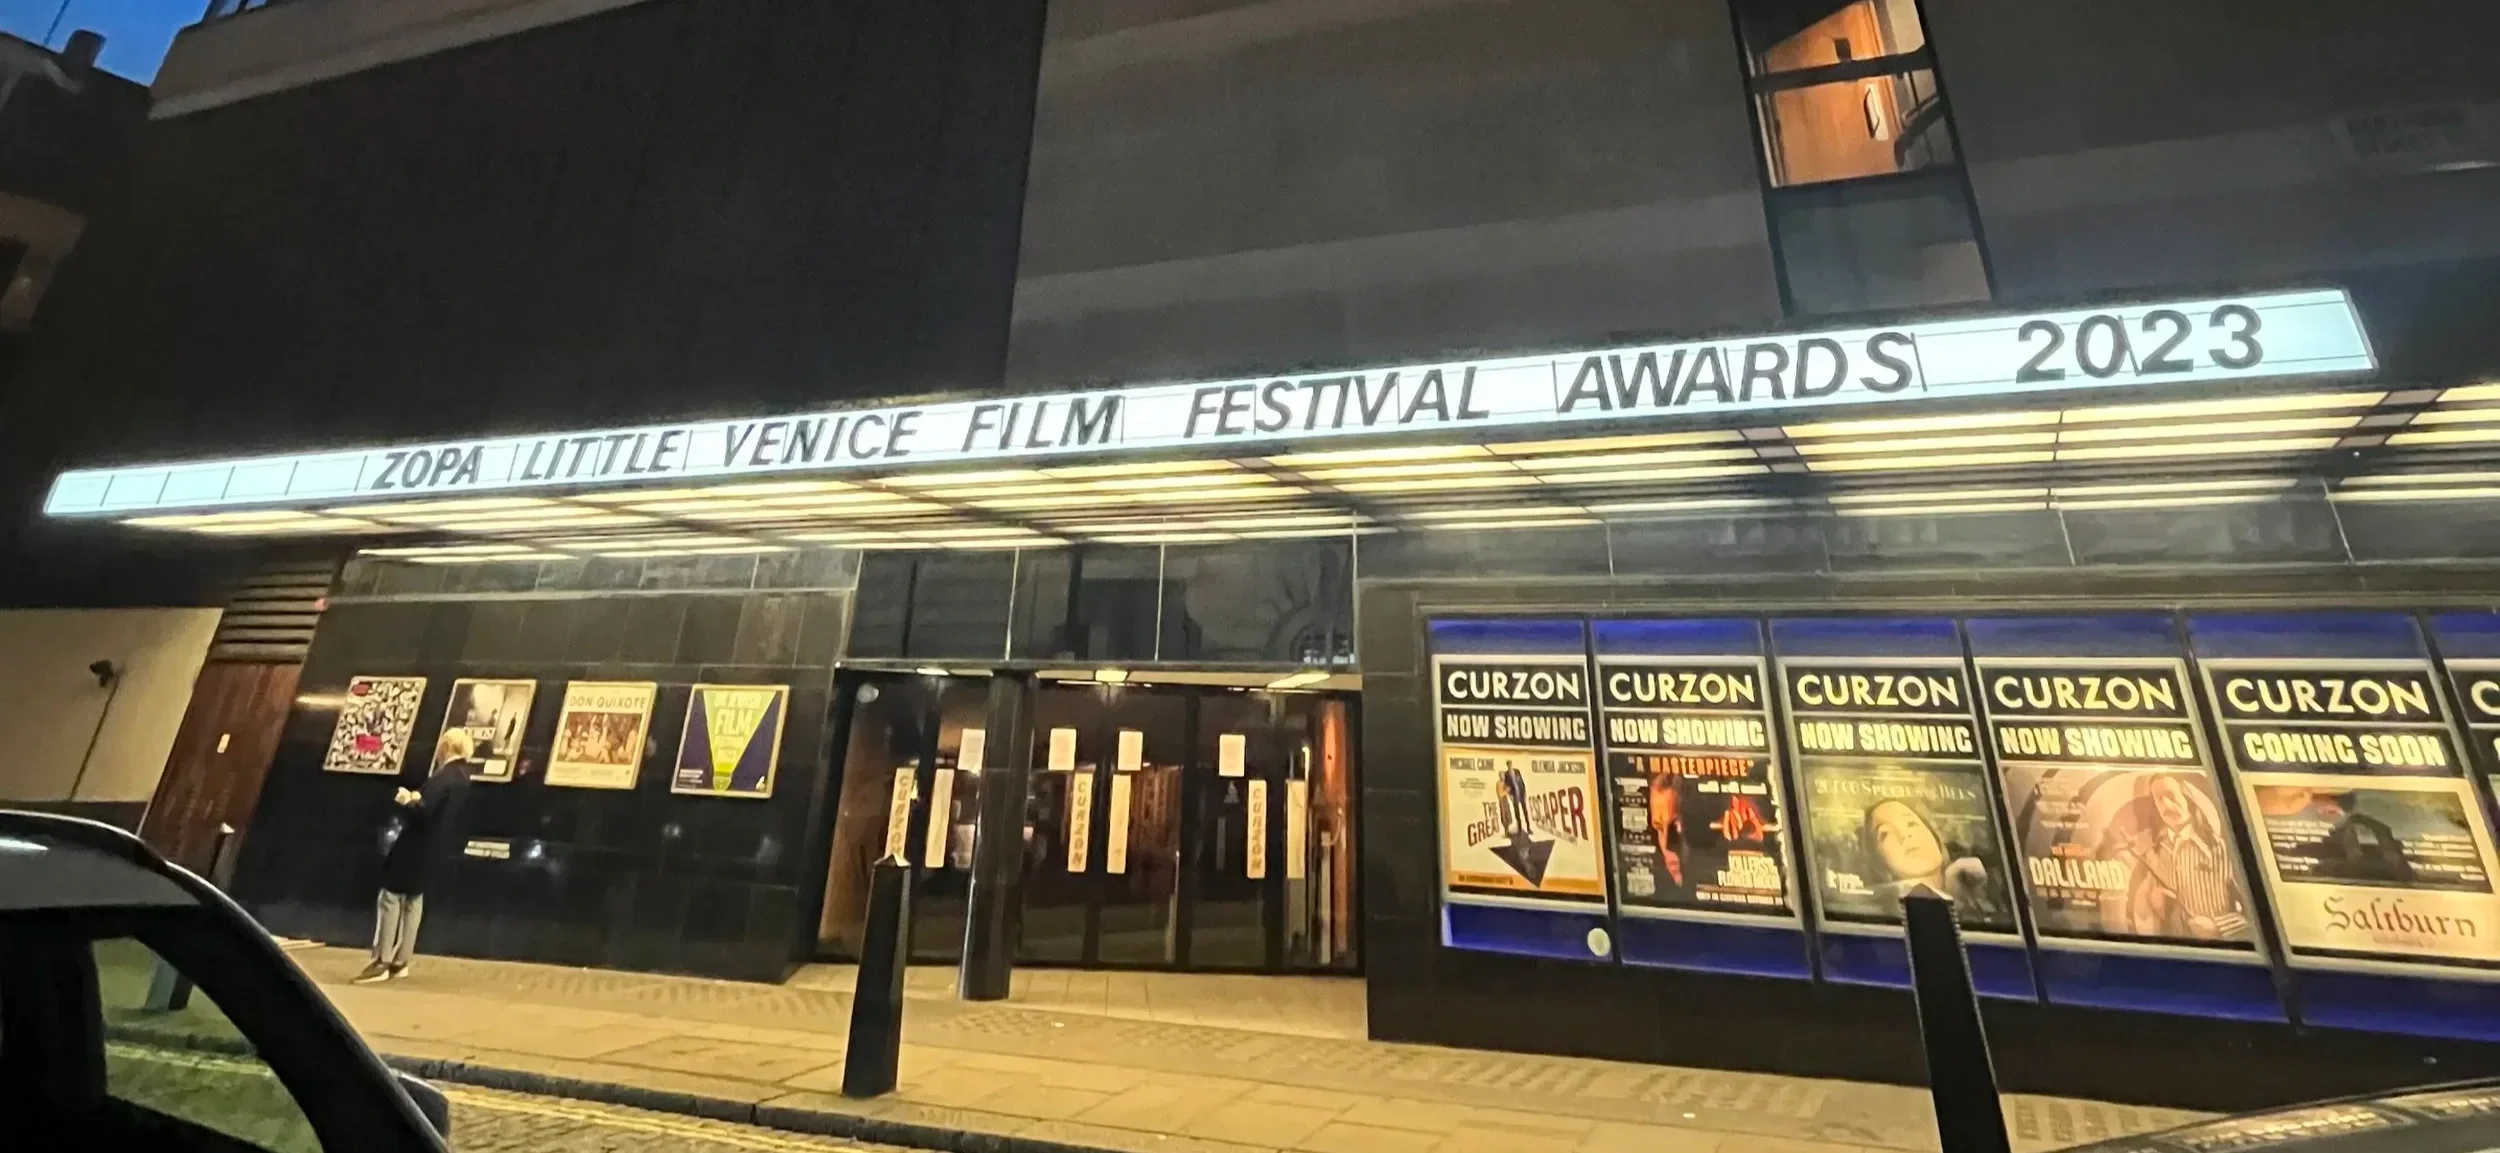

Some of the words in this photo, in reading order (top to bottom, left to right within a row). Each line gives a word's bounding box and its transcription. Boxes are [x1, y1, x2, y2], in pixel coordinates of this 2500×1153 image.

[371, 445, 485, 490] ZOPA
[519, 430, 681, 481] LITTLE
[723, 410, 925, 466] VENICE
[962, 395, 1122, 452] FILM
[1183, 365, 1491, 439] FESTIVAL
[1557, 331, 1917, 414] AWARDS
[2016, 303, 2264, 384] 2023
[569, 695, 593, 708] DON
[596, 695, 648, 709] QUIXOTE
[1447, 671, 1580, 701] CURZON
[1609, 672, 1756, 703] CURZON
[1797, 674, 1960, 708] CURZON
[1994, 675, 2176, 711] CURZON
[2226, 678, 2431, 716] CURZON
[1447, 714, 1490, 738] NOW
[1495, 715, 1586, 742] SHOWING
[1610, 718, 1659, 744] NOW
[1663, 718, 1766, 747] SHOWING
[1800, 722, 1855, 751] NOW
[1859, 724, 1973, 754] SHOWING
[2000, 727, 2062, 757] NOW
[2067, 727, 2194, 760] SHOWING
[2243, 731, 2359, 765] COMING
[2360, 734, 2447, 767] SOON
[1071, 781, 1088, 865] CURZON
[1251, 788, 1263, 870] CURZON
[1528, 786, 1589, 841] ESCAPER
[1467, 818, 1500, 848] GREAT
[2028, 855, 2126, 891] DALILAND
